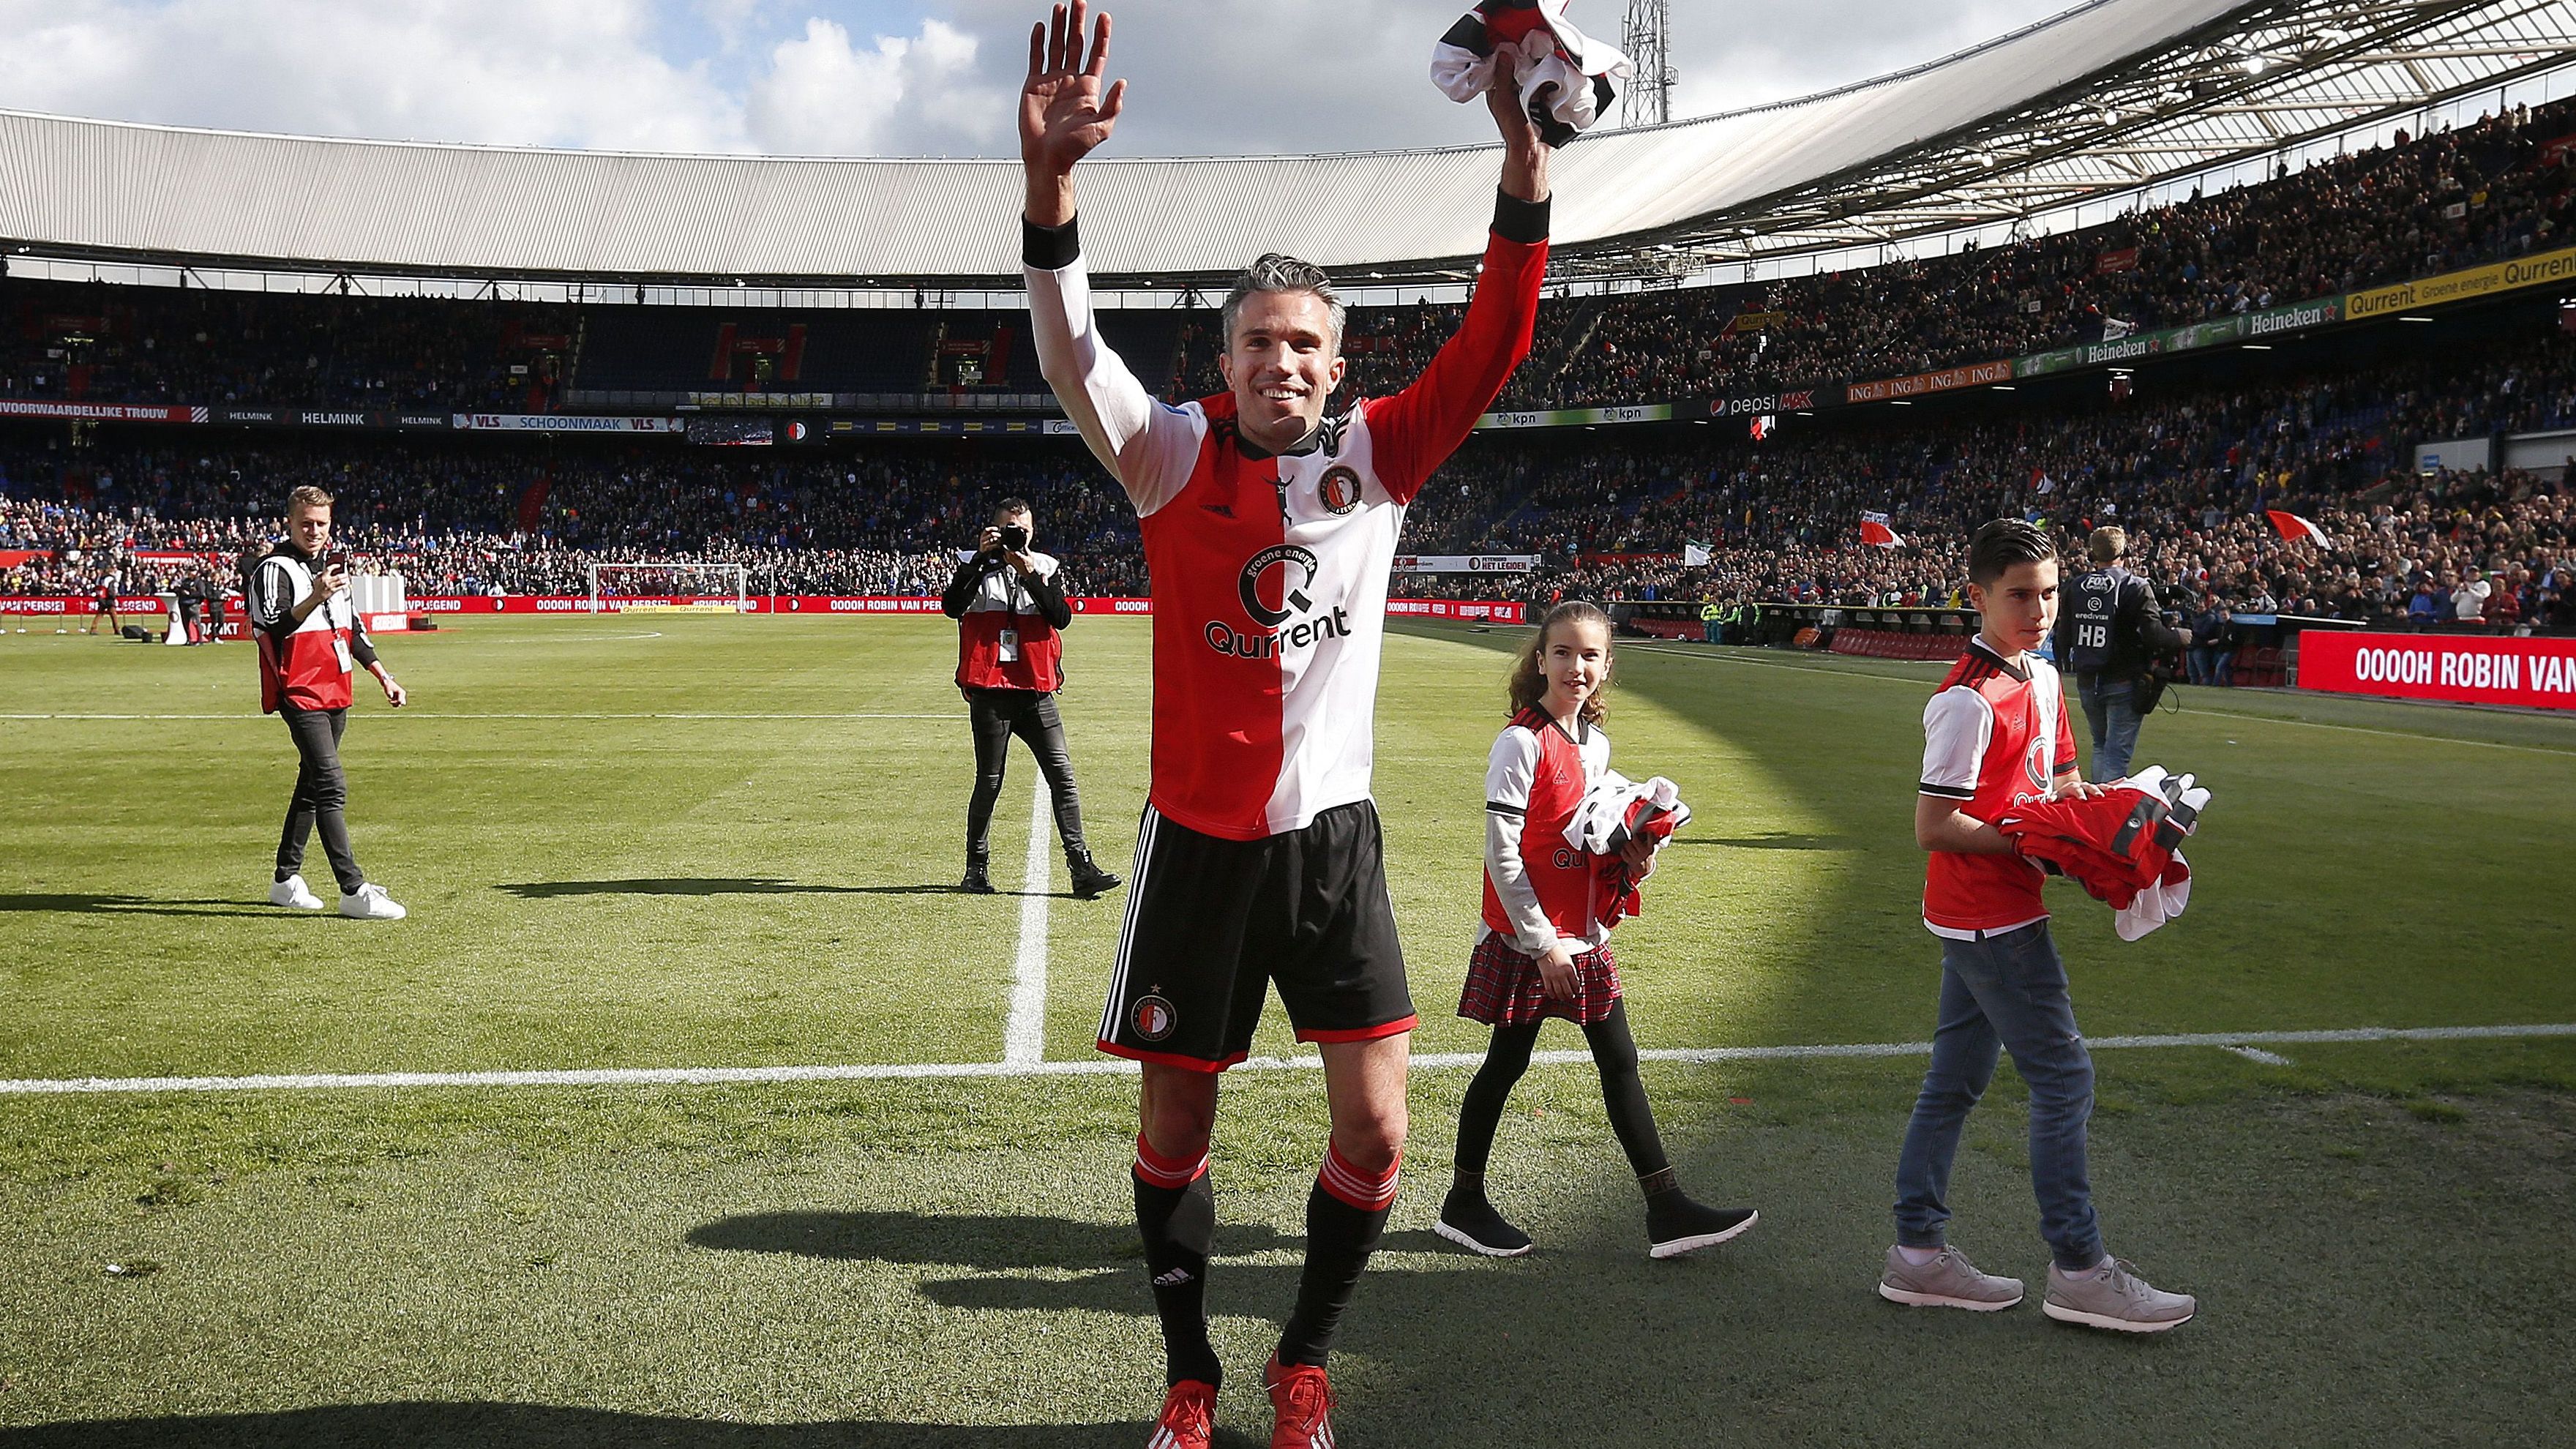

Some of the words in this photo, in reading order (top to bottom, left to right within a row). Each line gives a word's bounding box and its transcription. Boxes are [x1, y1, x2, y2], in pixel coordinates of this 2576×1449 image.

[2505, 252, 2576, 284] Qurren
[2422, 282, 2459, 299] Groene
[2460, 274, 2499, 291] energie
[2351, 285, 2416, 315] Qurrent
[2250, 307, 2321, 335] Heineken
[2088, 340, 2146, 364] Heineken
[1931, 374, 1952, 389] ING
[1972, 367, 1993, 383] ING
[1850, 386, 1871, 401] ING
[1890, 380, 1911, 395] ING
[1731, 394, 1775, 415] pepsi
[1778, 389, 1815, 411] MAX
[0, 402, 122, 417] VOORWAARDELIJKE
[124, 407, 168, 419] TROUW
[229, 411, 272, 421] HELMINK
[302, 412, 364, 424] HELMINK
[1619, 408, 1641, 419] kpn
[401, 416, 442, 424] HELMINK
[476, 416, 501, 427] VLS
[520, 416, 621, 430] SCHOONMAAK
[631, 418, 654, 430] VLS
[1513, 413, 1535, 425] kpn
[1247, 550, 1281, 577] groene
[1285, 549, 1316, 572] energie
[1483, 562, 1495, 570] HET
[2086, 576, 2108, 586] FOX
[609, 599, 629, 610] VAN
[831, 599, 864, 610] OOOOH
[867, 599, 898, 610] ROBIN
[900, 599, 921, 610] VAN
[1115, 601, 1149, 611] OOOOH
[1204, 605, 1352, 659] Qurrent
[2078, 624, 2105, 647] HB
[2355, 647, 2433, 685] OOOOH
[2440, 651, 2520, 690] ROBIN
[2528, 655, 2576, 693] VAN
